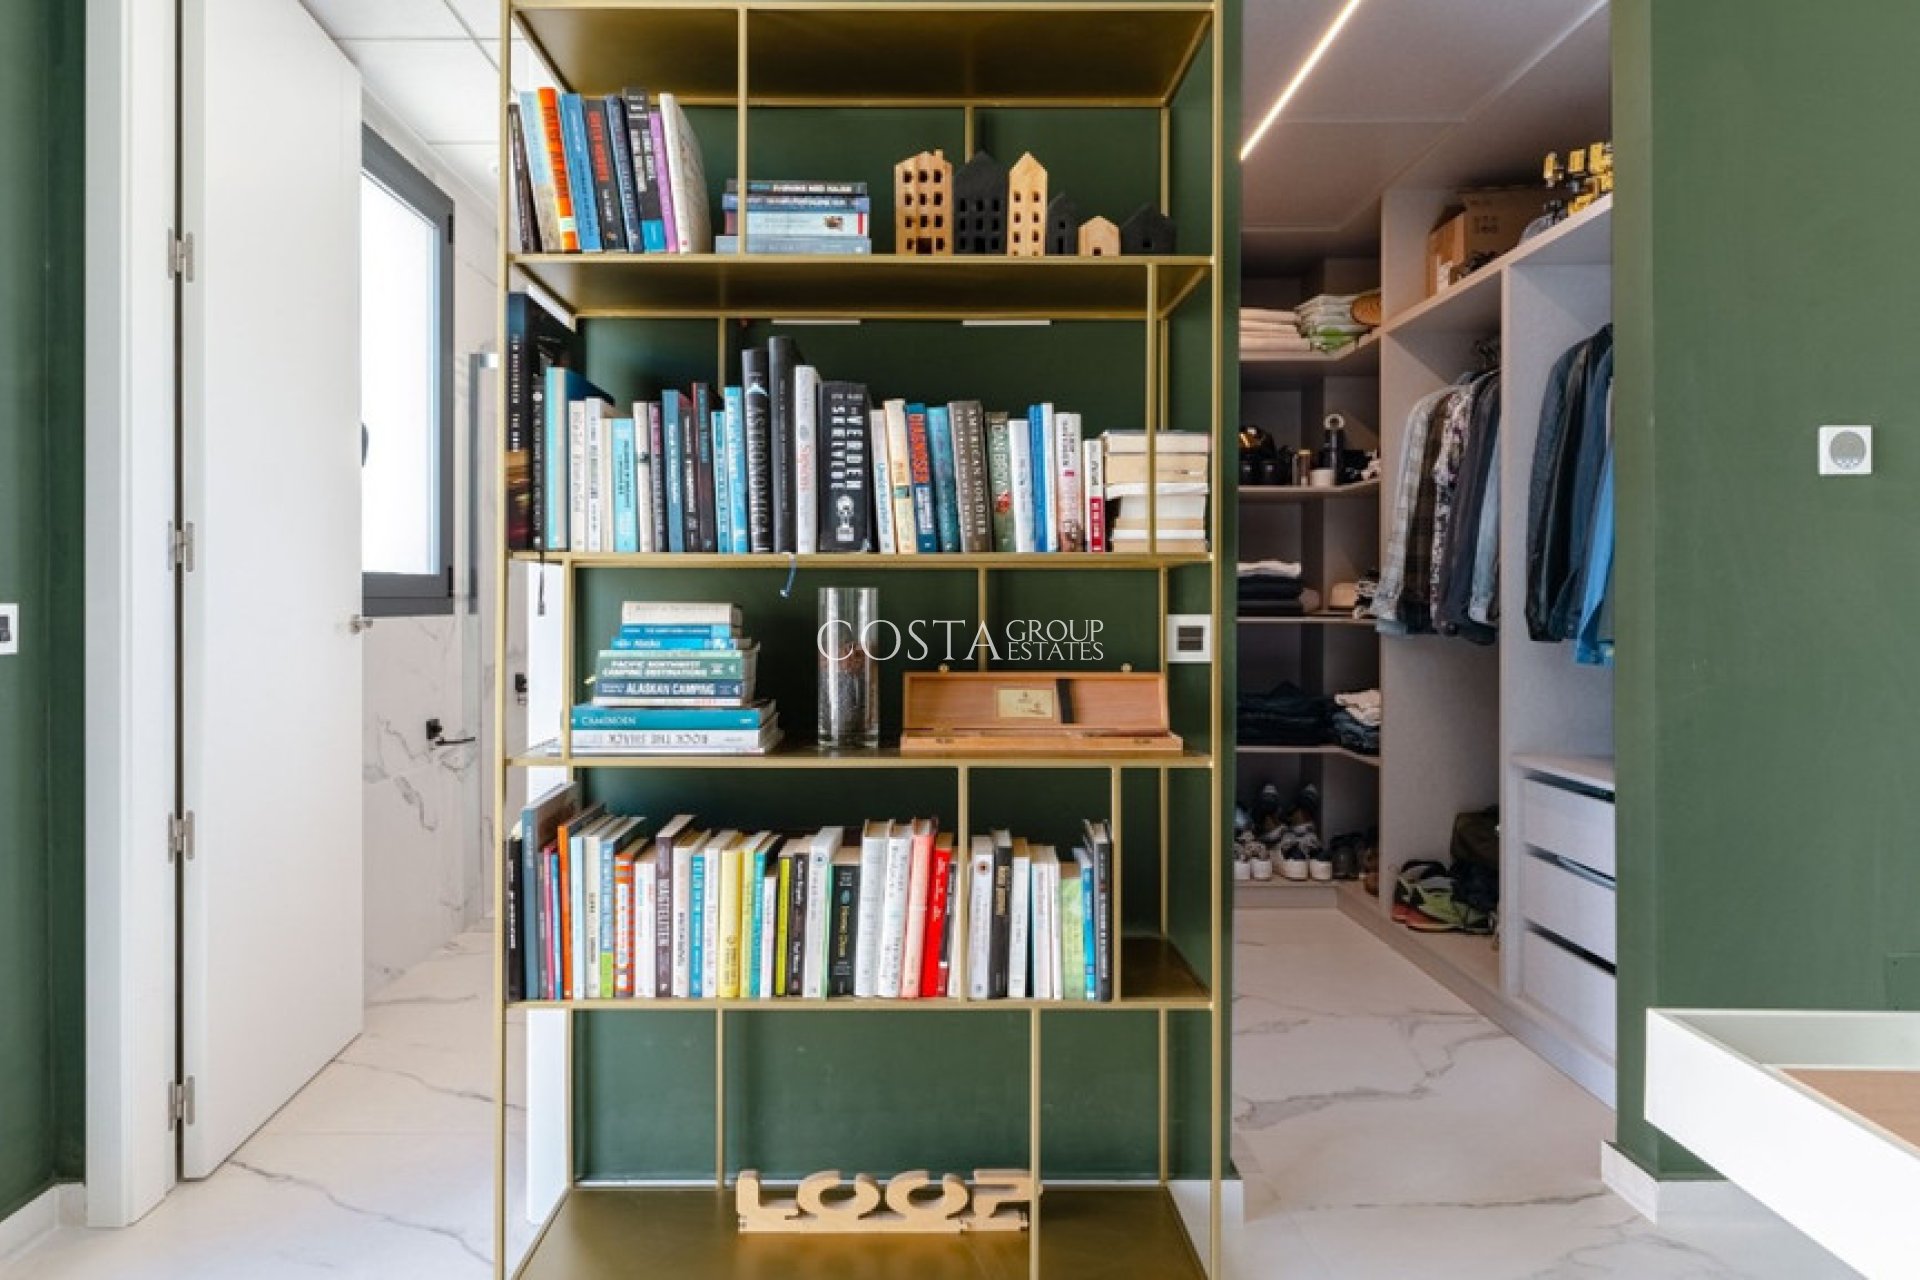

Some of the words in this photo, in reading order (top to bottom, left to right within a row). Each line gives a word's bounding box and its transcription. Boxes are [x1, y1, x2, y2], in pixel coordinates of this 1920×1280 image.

[748, 406, 770, 535] ASTRONOMICA
[967, 409, 982, 475] AMERICAN
[975, 480, 987, 535] SOLDIER
[626, 683, 670, 695] ALASKAN
[672, 683, 715, 695] CAMPING
